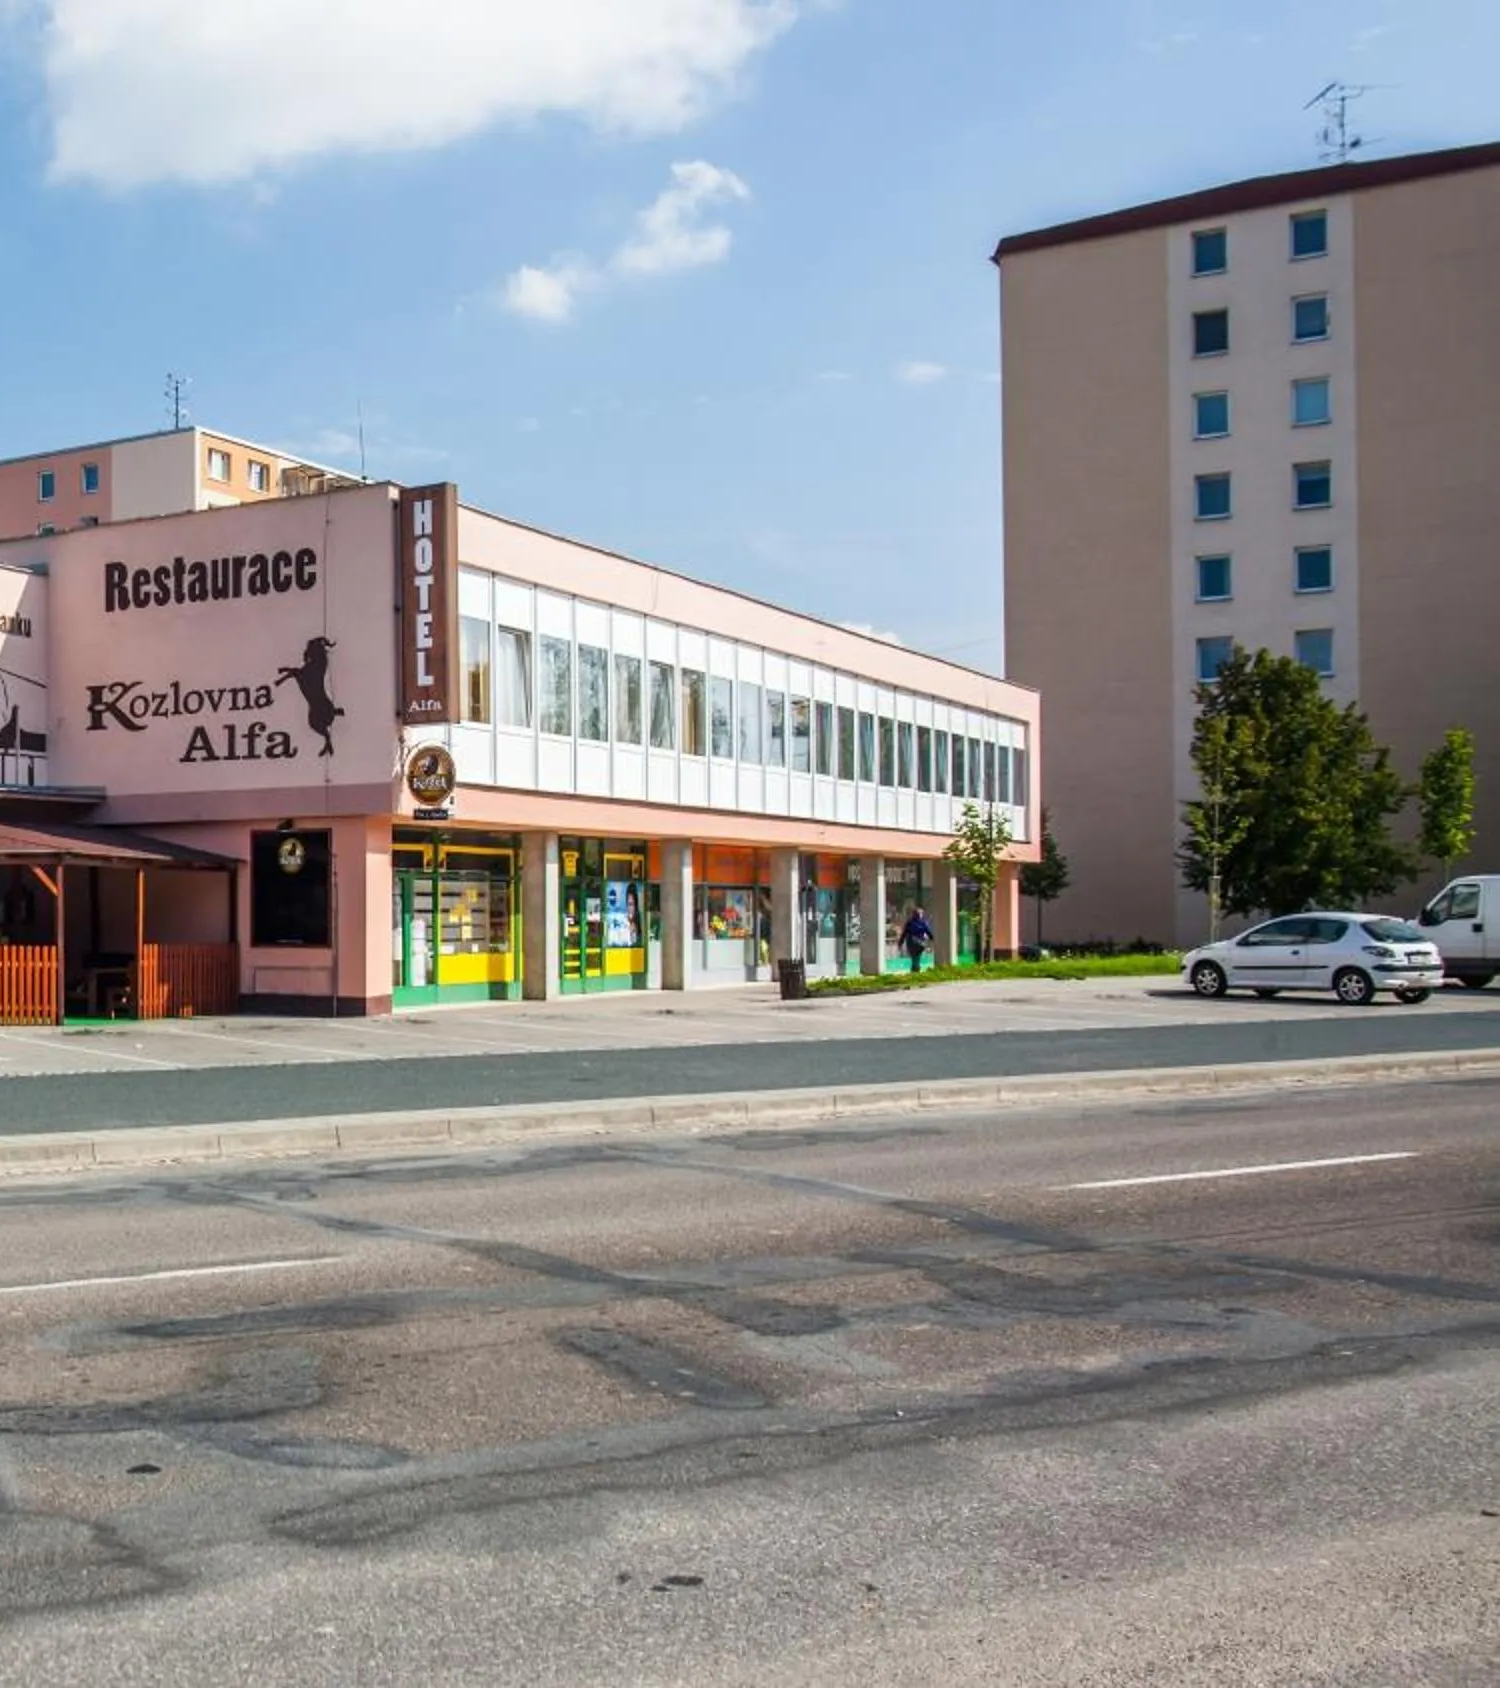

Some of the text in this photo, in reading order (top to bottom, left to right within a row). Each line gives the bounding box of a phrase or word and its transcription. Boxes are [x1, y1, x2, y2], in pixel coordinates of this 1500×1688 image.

[104, 547, 318, 613] Restaurace
[413, 500, 434, 687] HOTEL
[85, 681, 274, 733] Kozlovna
[409, 698, 443, 713] Alfa
[180, 721, 298, 763] Alfa
